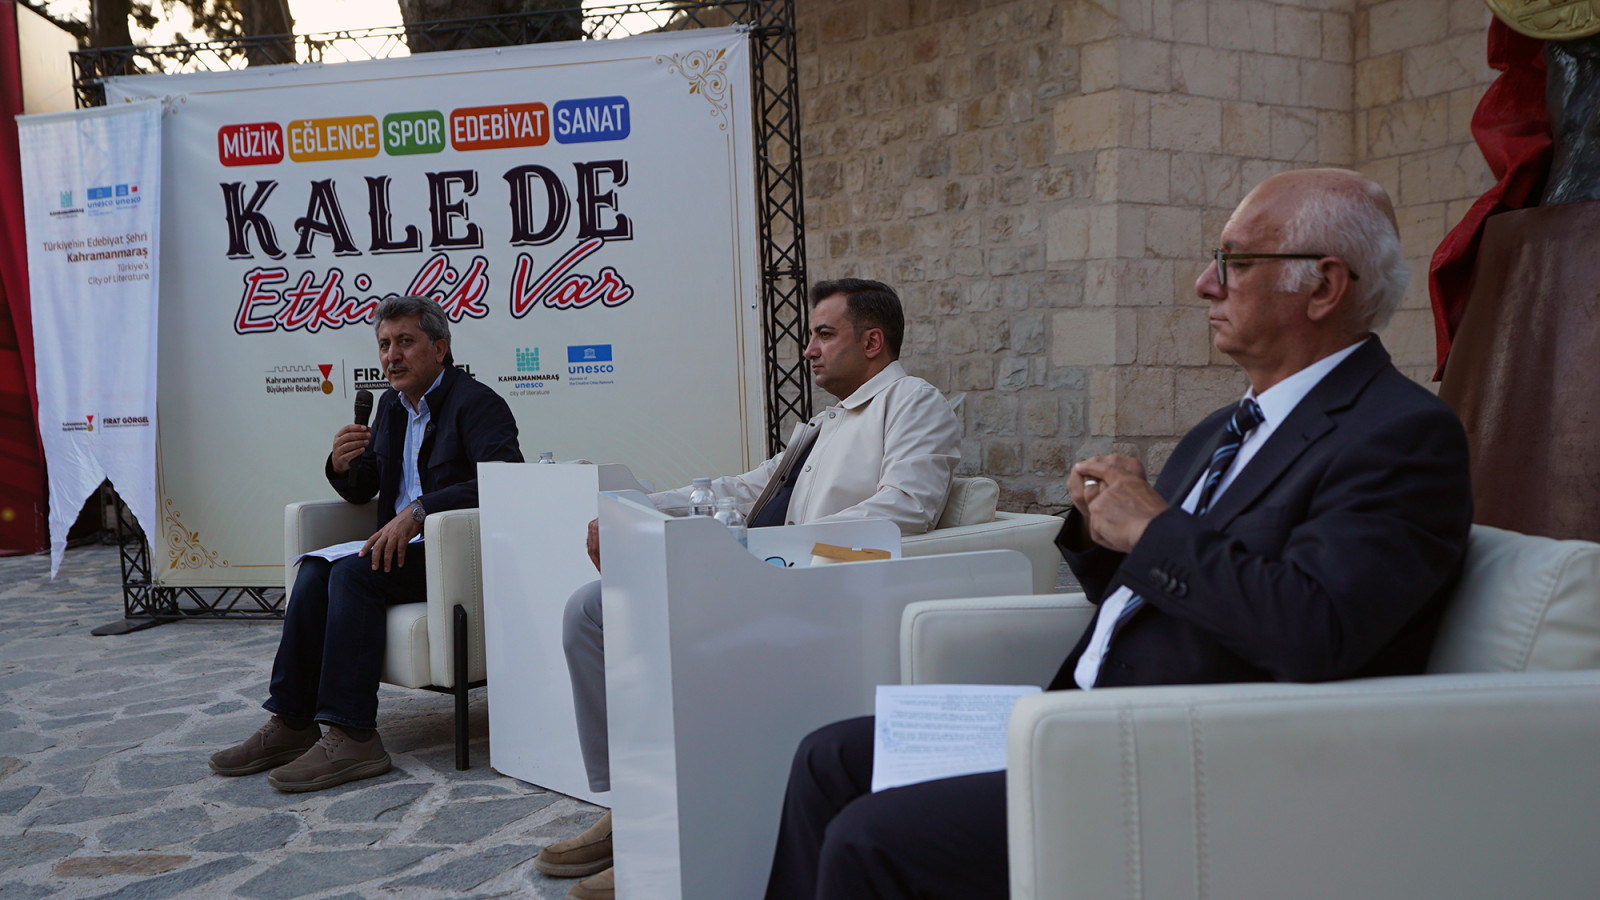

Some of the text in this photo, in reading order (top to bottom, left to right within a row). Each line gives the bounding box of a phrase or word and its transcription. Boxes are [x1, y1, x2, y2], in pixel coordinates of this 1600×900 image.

[454, 109, 545, 142] EDEBİYAT
[558, 104, 625, 135] SANAT
[292, 121, 376, 154] EĞLENCE
[388, 119, 441, 147] SPOR
[223, 129, 281, 158] MÜZİK
[87, 200, 113, 208] unesco
[220, 160, 634, 260] KALE DE
[87, 235, 124, 248] Edebiyat
[126, 232, 148, 244] Şehri
[67, 247, 148, 262] Kahramanmaraş
[88, 276, 102, 285] City
[113, 273, 150, 283] Literature
[510, 237, 633, 319] Var
[568, 364, 614, 374] unesco
[265, 376, 320, 384] Kahramanmaraş
[498, 374, 560, 382] KAHRAMANMARAŞ
[515, 381, 544, 389] unesco
[266, 384, 321, 394] Büyükşehir Belediyesi
